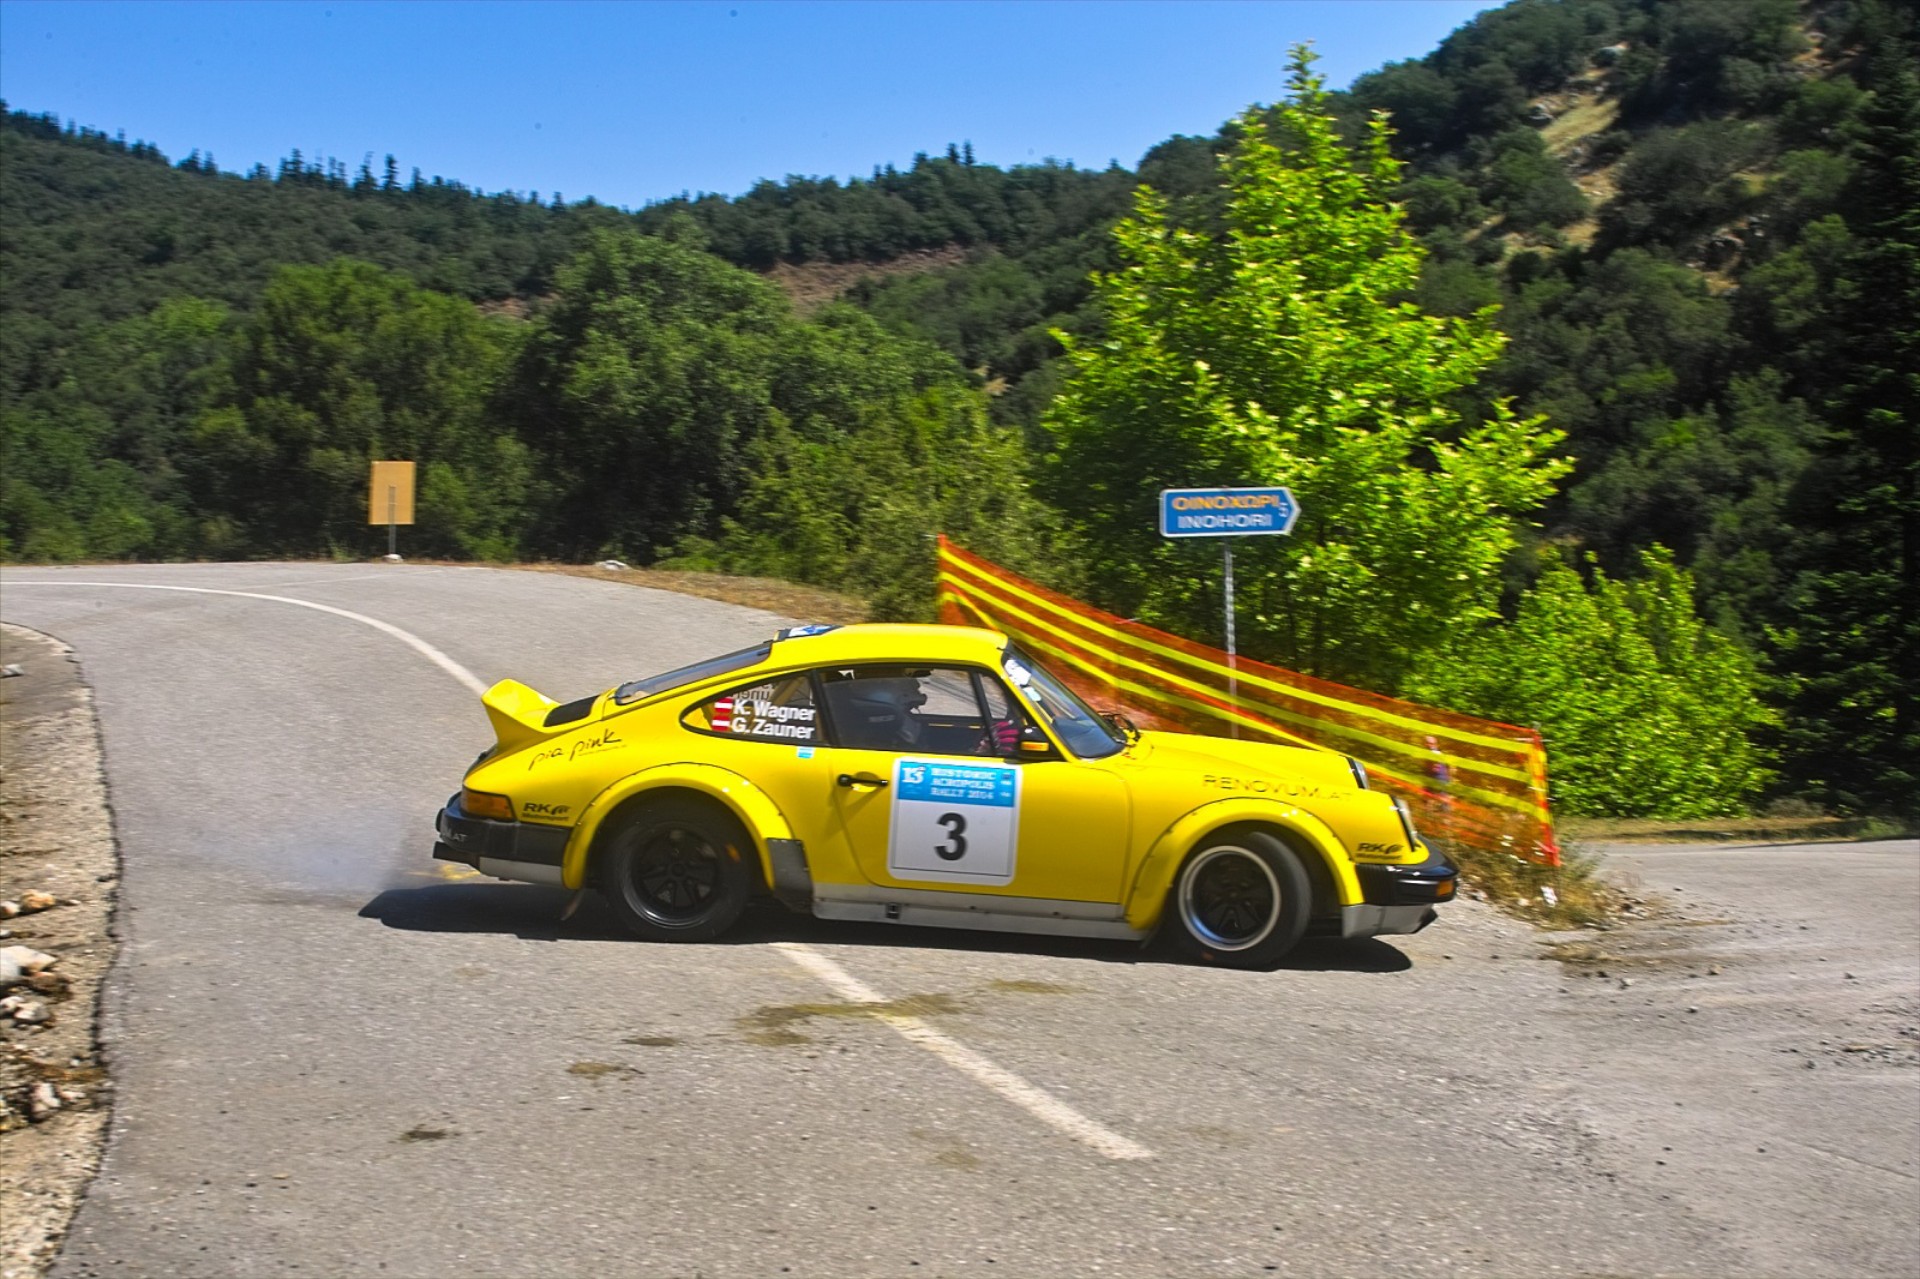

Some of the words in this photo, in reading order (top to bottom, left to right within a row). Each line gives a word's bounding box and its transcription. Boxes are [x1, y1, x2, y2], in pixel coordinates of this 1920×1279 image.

[1177, 514, 1272, 528] INOHORI
[733, 699, 750, 715] K.
[753, 702, 816, 722] Wagner
[731, 718, 750, 733] G.
[752, 719, 815, 739] Zauner
[569, 728, 622, 761] pink
[931, 768, 996, 780] HISTORIC
[934, 812, 968, 861] 3
